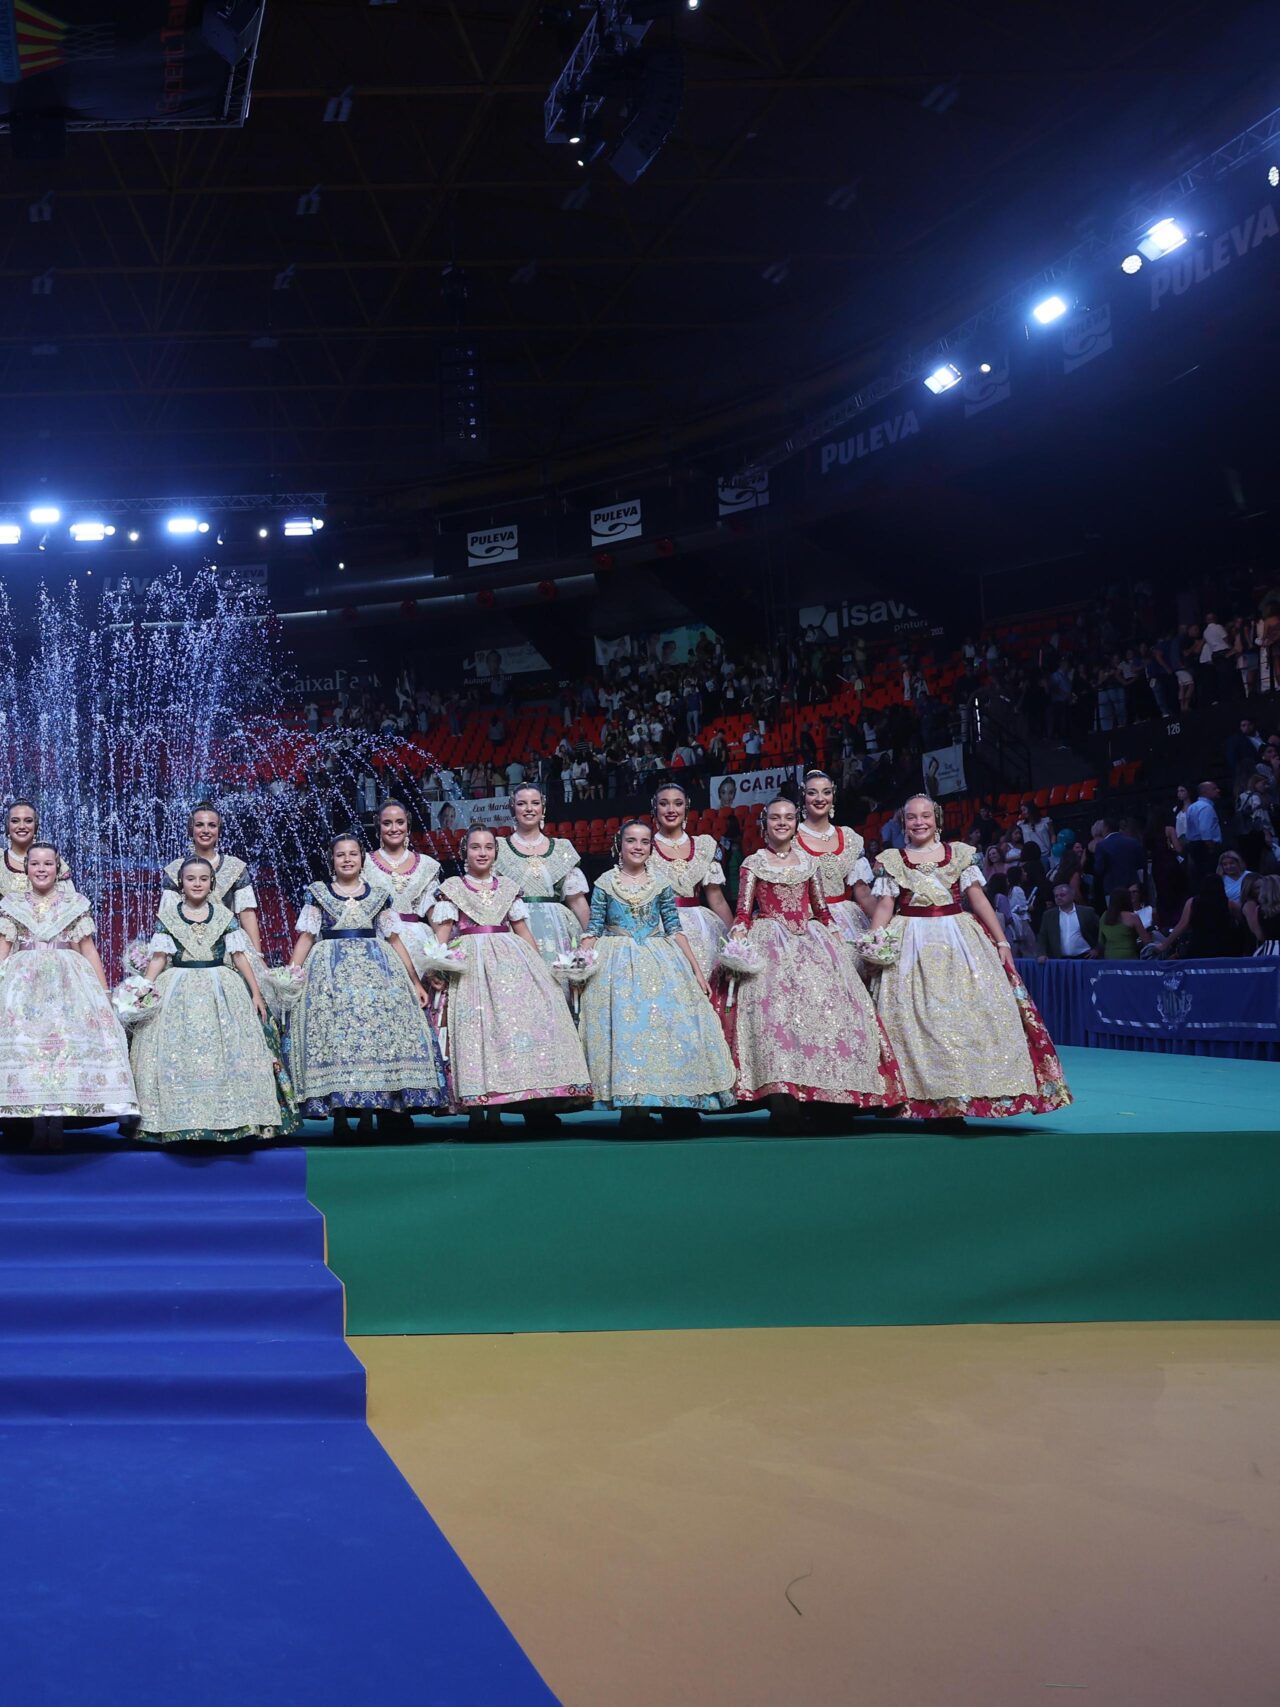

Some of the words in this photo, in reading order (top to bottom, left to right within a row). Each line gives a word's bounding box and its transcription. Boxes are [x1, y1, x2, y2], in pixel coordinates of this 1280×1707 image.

[1151, 203, 1280, 311] PULEVA
[820, 409, 920, 474] PULEVA
[594, 506, 638, 525] PULEVA
[470, 532, 515, 547] PULEVA
[1166, 722, 1181, 736] 126
